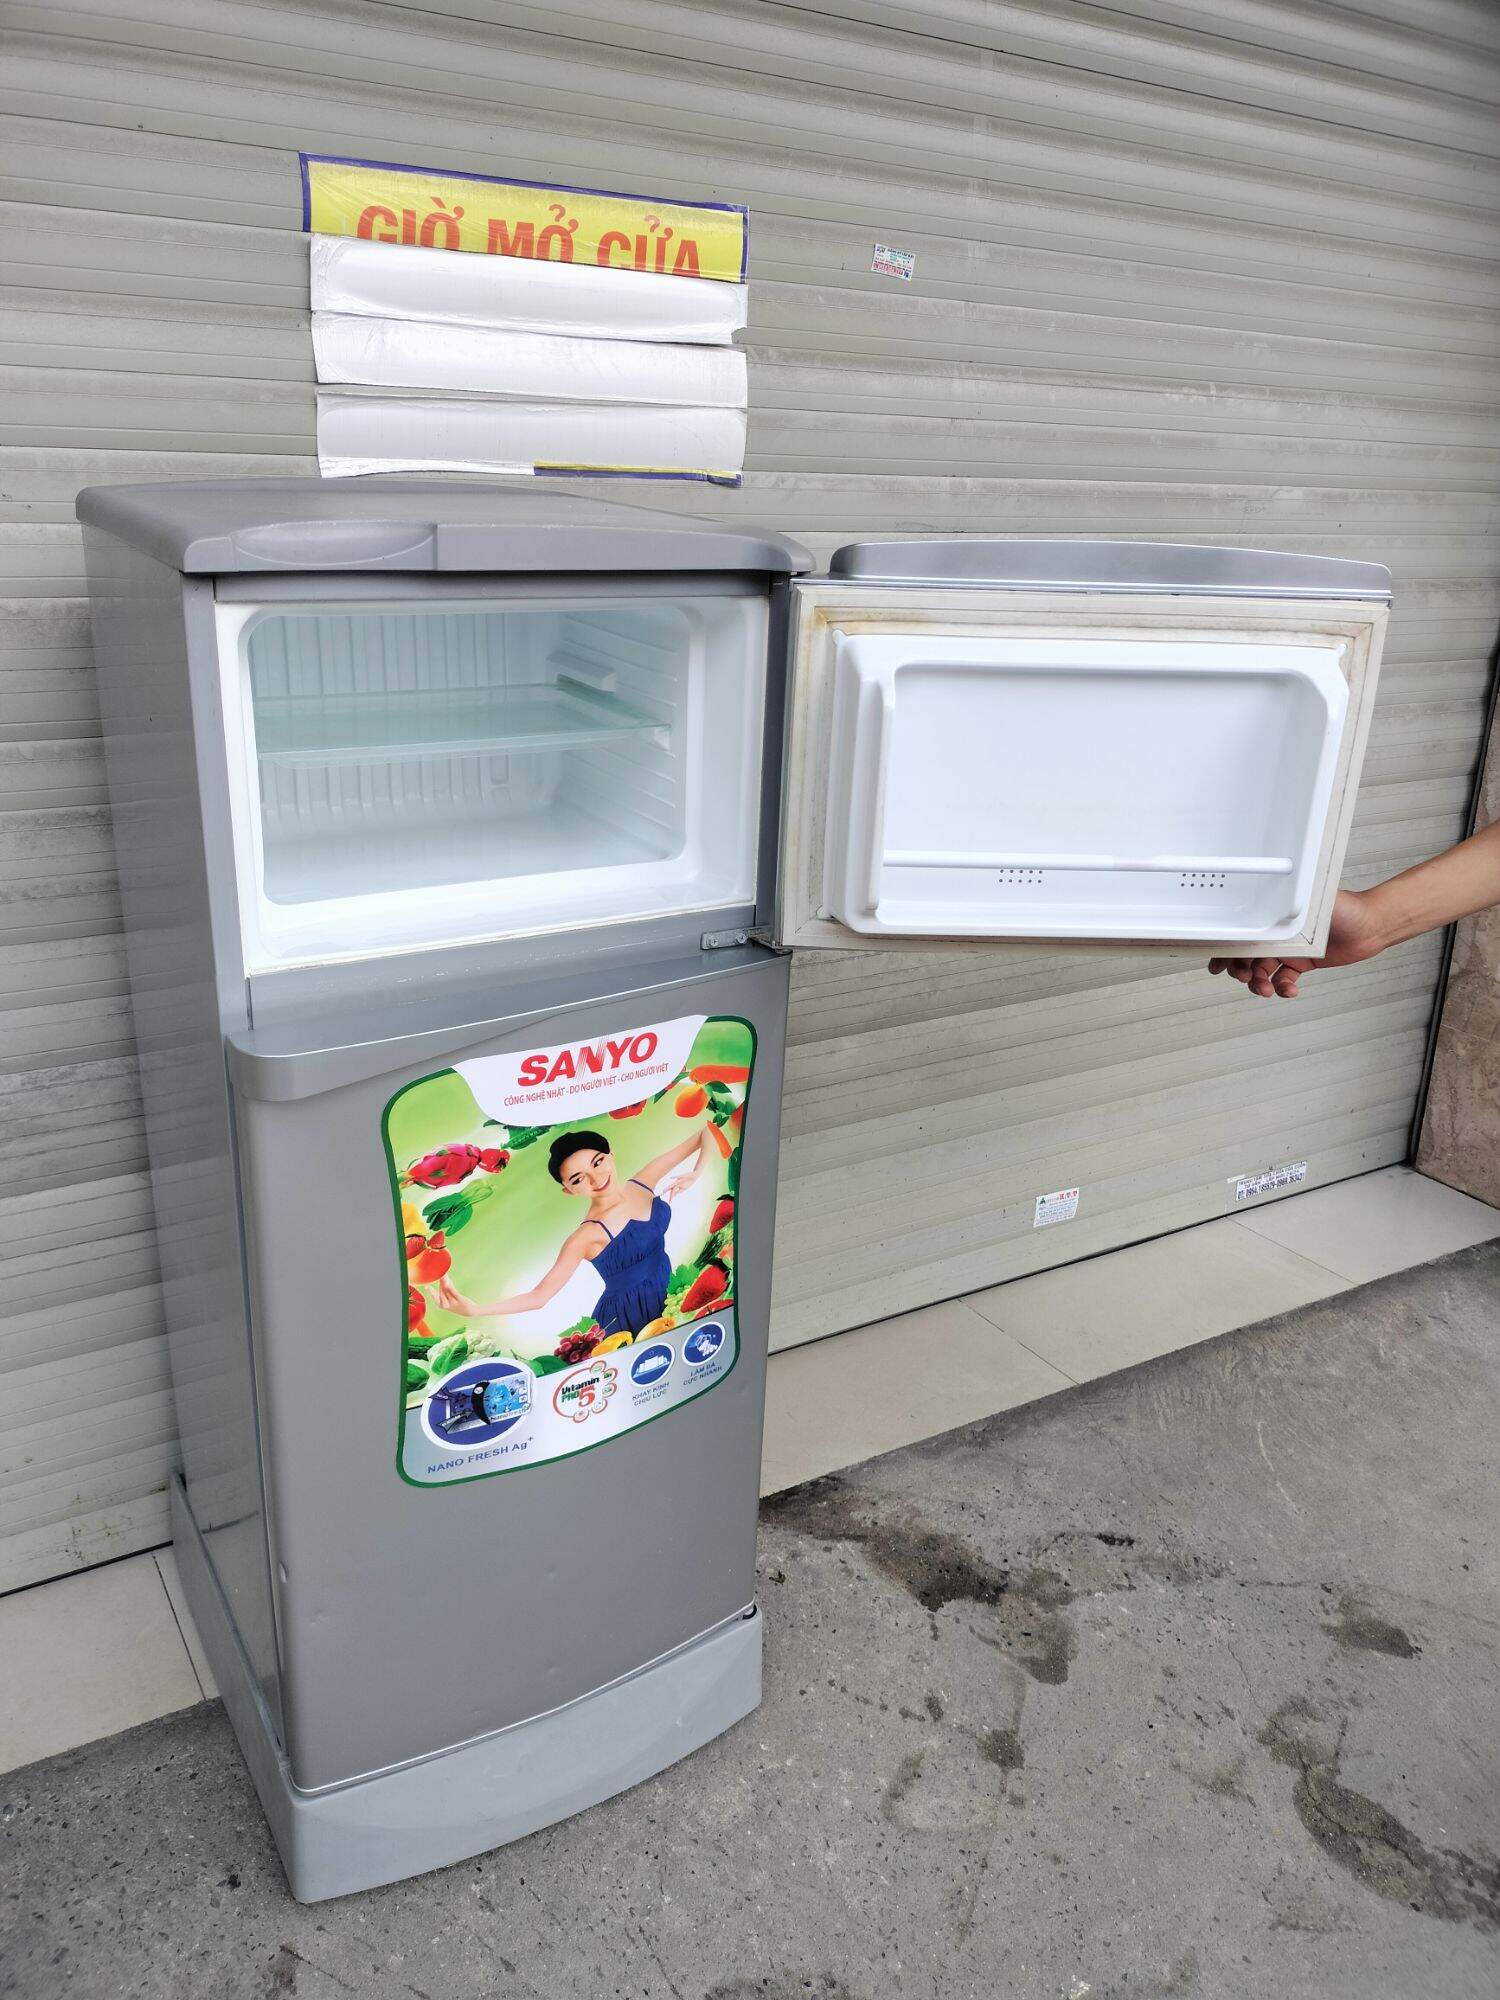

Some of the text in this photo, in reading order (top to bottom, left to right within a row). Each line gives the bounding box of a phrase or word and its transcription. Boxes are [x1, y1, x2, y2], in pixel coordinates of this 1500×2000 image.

[357, 197, 702, 279] GIỜ MỞ CỬA
[517, 1032, 658, 1087] SANYO
[561, 1377, 600, 1395] Vitamin
[427, 1458, 465, 1474] NANO
[468, 1446, 509, 1463] FRESH
